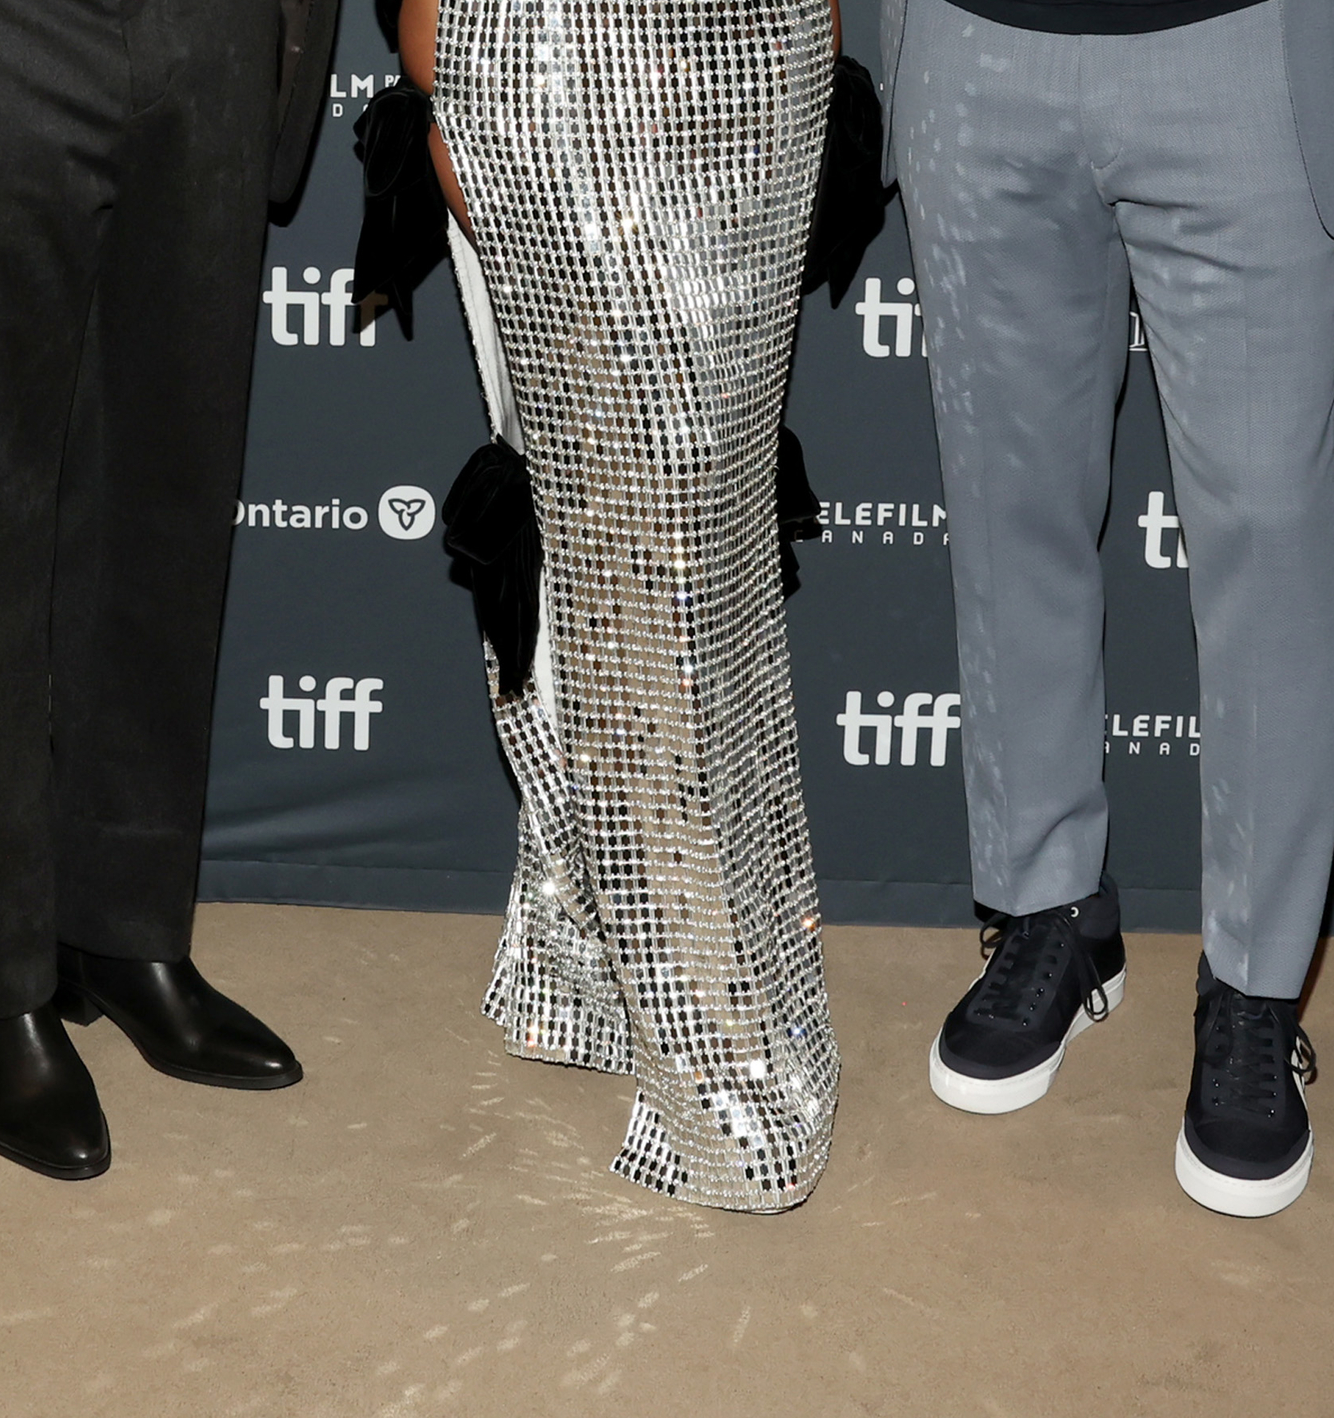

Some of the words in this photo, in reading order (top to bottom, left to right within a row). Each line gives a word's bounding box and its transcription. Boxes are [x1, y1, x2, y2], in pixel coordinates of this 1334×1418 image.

[855, 277, 928, 358] ti
[815, 501, 947, 527] ELEFILM
[259, 674, 384, 751] tiff
[836, 690, 962, 767] tiff
[1104, 714, 1201, 738] LEFIL
